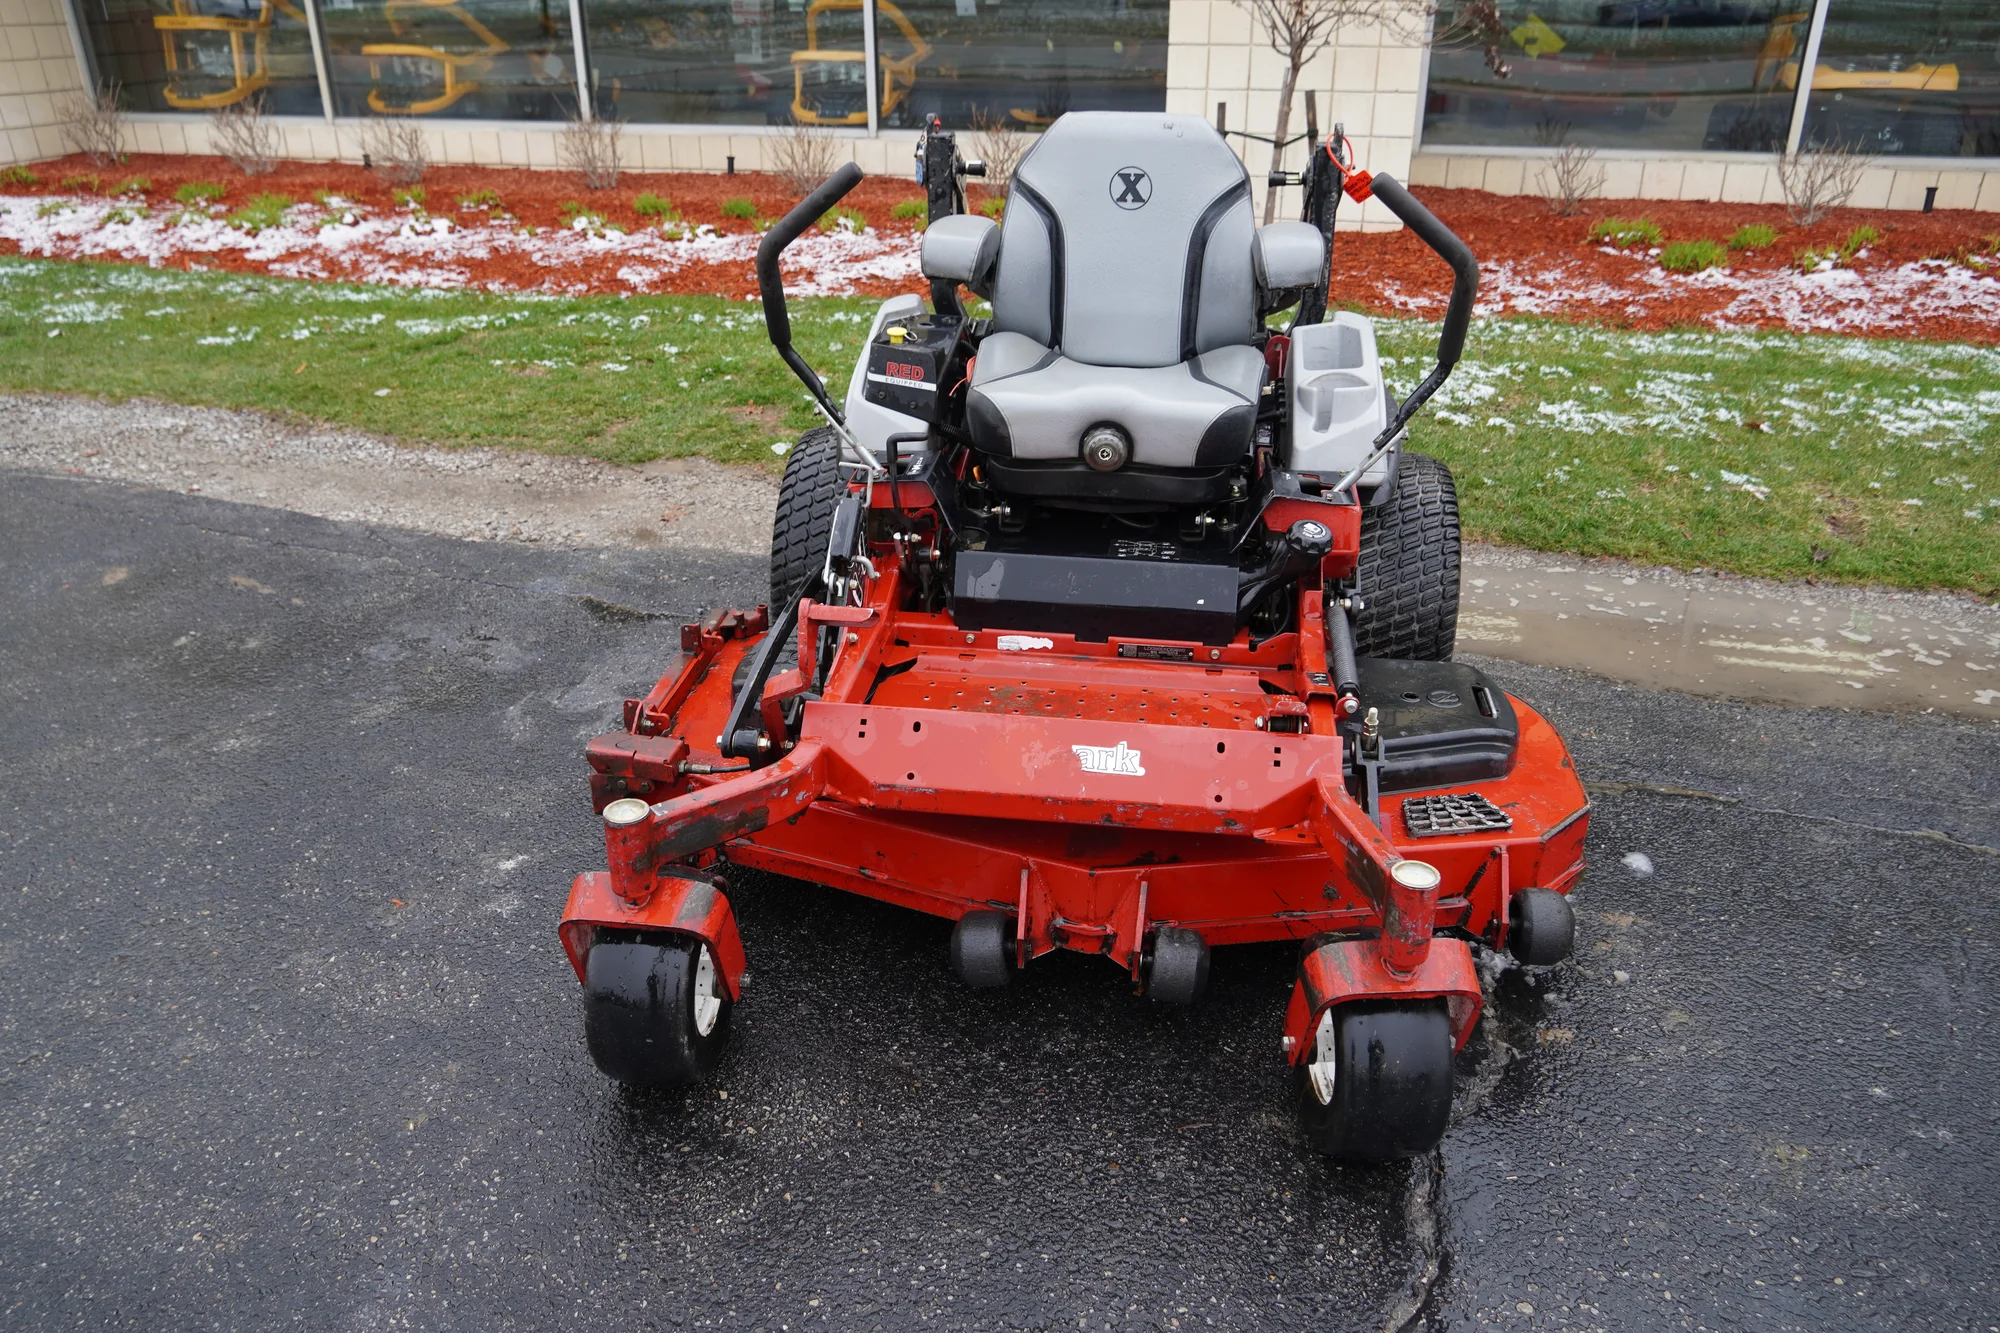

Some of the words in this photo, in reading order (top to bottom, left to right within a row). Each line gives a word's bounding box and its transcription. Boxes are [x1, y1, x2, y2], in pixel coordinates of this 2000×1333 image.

[1115, 172, 1146, 203] X
[885, 377, 923, 388] EQUIPPED
[886, 361, 925, 381] RED
[1075, 743, 1138, 774] ark
